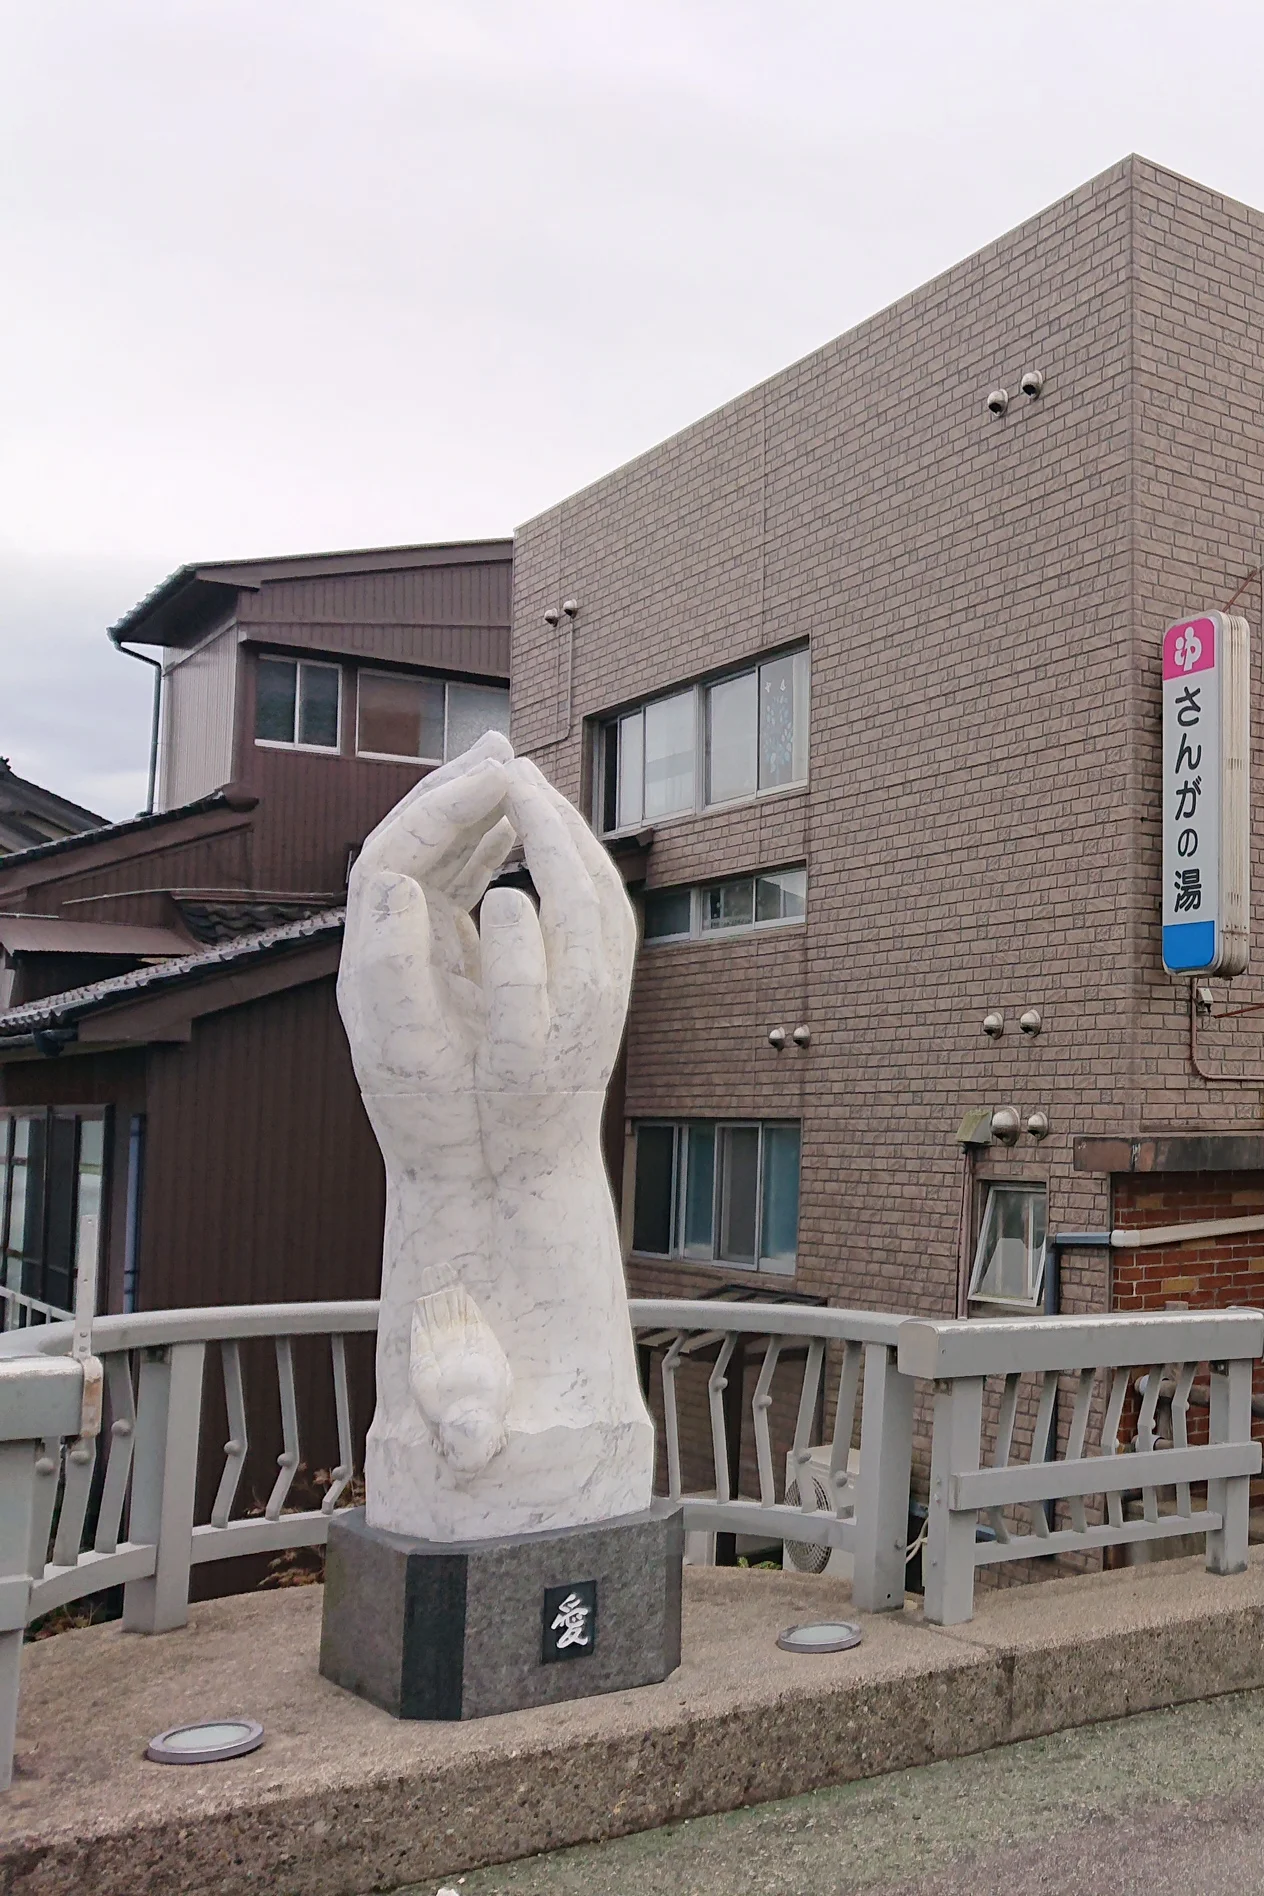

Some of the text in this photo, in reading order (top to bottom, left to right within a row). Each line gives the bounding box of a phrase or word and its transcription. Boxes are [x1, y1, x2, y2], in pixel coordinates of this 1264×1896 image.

[1174, 686, 1203, 913] さんがの湯
[551, 1592, 589, 1649] 愛
